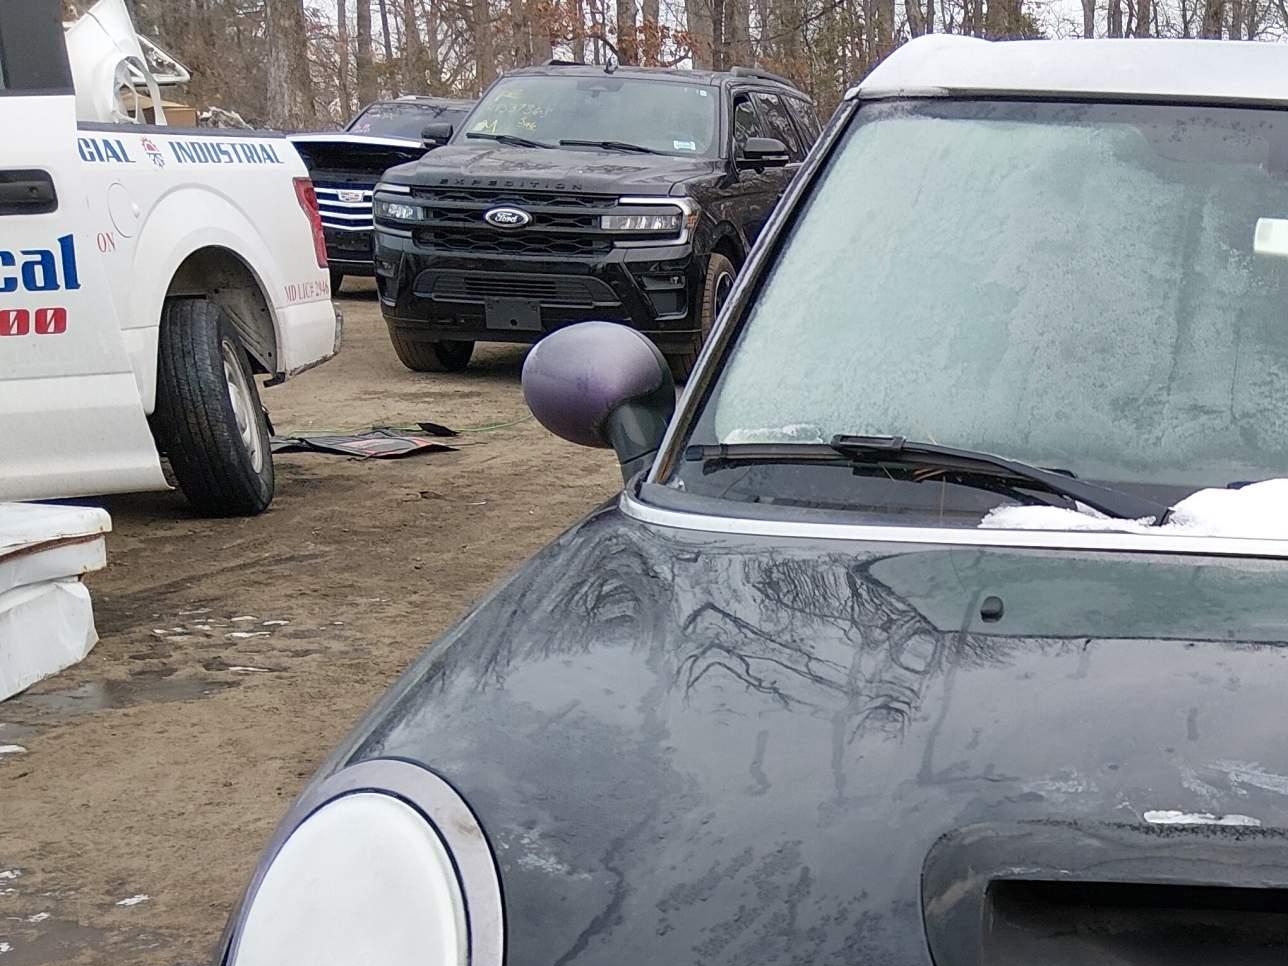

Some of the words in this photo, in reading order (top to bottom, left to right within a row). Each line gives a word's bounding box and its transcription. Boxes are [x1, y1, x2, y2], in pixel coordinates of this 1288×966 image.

[168, 141, 285, 164] INDUSTRIAL
[439, 177, 583, 191] EXPEDITION
[494, 211, 519, 223] Ford
[97, 232, 116, 253] ON
